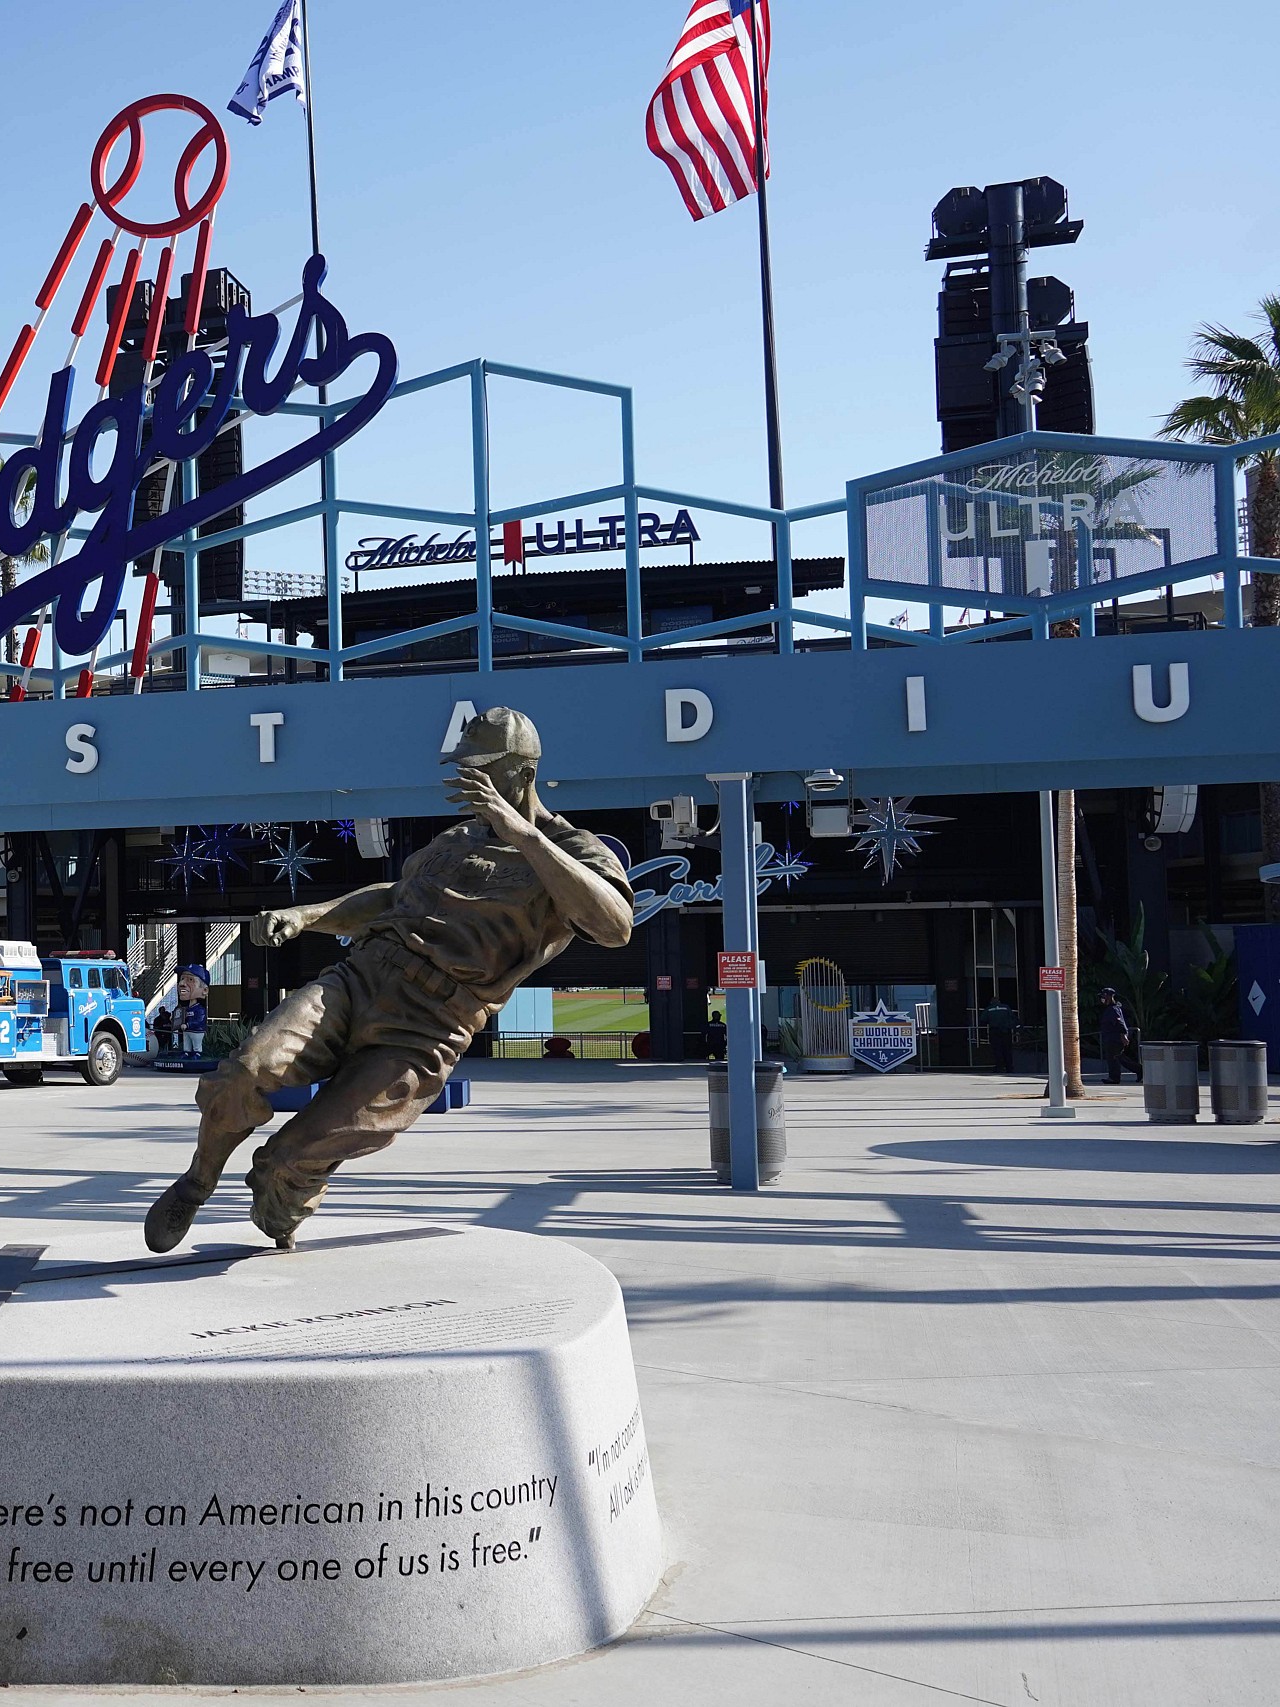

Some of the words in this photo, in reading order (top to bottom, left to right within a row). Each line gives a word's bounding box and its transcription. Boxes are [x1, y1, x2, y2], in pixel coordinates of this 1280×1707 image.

[966, 457, 1102, 494] Michelob
[535, 508, 701, 556] ULTRA
[939, 489, 1146, 541] ULTRA
[853, 1037, 913, 1048] CHAMPIONS
[865, 1027, 900, 1037] WORLD
[878, 1050, 888, 1063] LA
[189, 1320, 296, 1339] JACKIE
[294, 1299, 458, 1323] ROBINSON
[79, 1499, 136, 1527] not
[144, 1505, 187, 1527] an
[198, 1493, 364, 1526] American
[377, 1492, 403, 1522] in
[415, 1483, 464, 1519] this
[470, 1475, 558, 1512] country
[7, 1547, 74, 1583] free
[87, 1547, 157, 1583] until
[168, 1560, 266, 1593] every
[277, 1559, 342, 1582] one
[354, 1542, 389, 1579] of
[398, 1554, 430, 1577] us
[440, 1542, 461, 1573] is
[472, 1526, 542, 1568] free."
